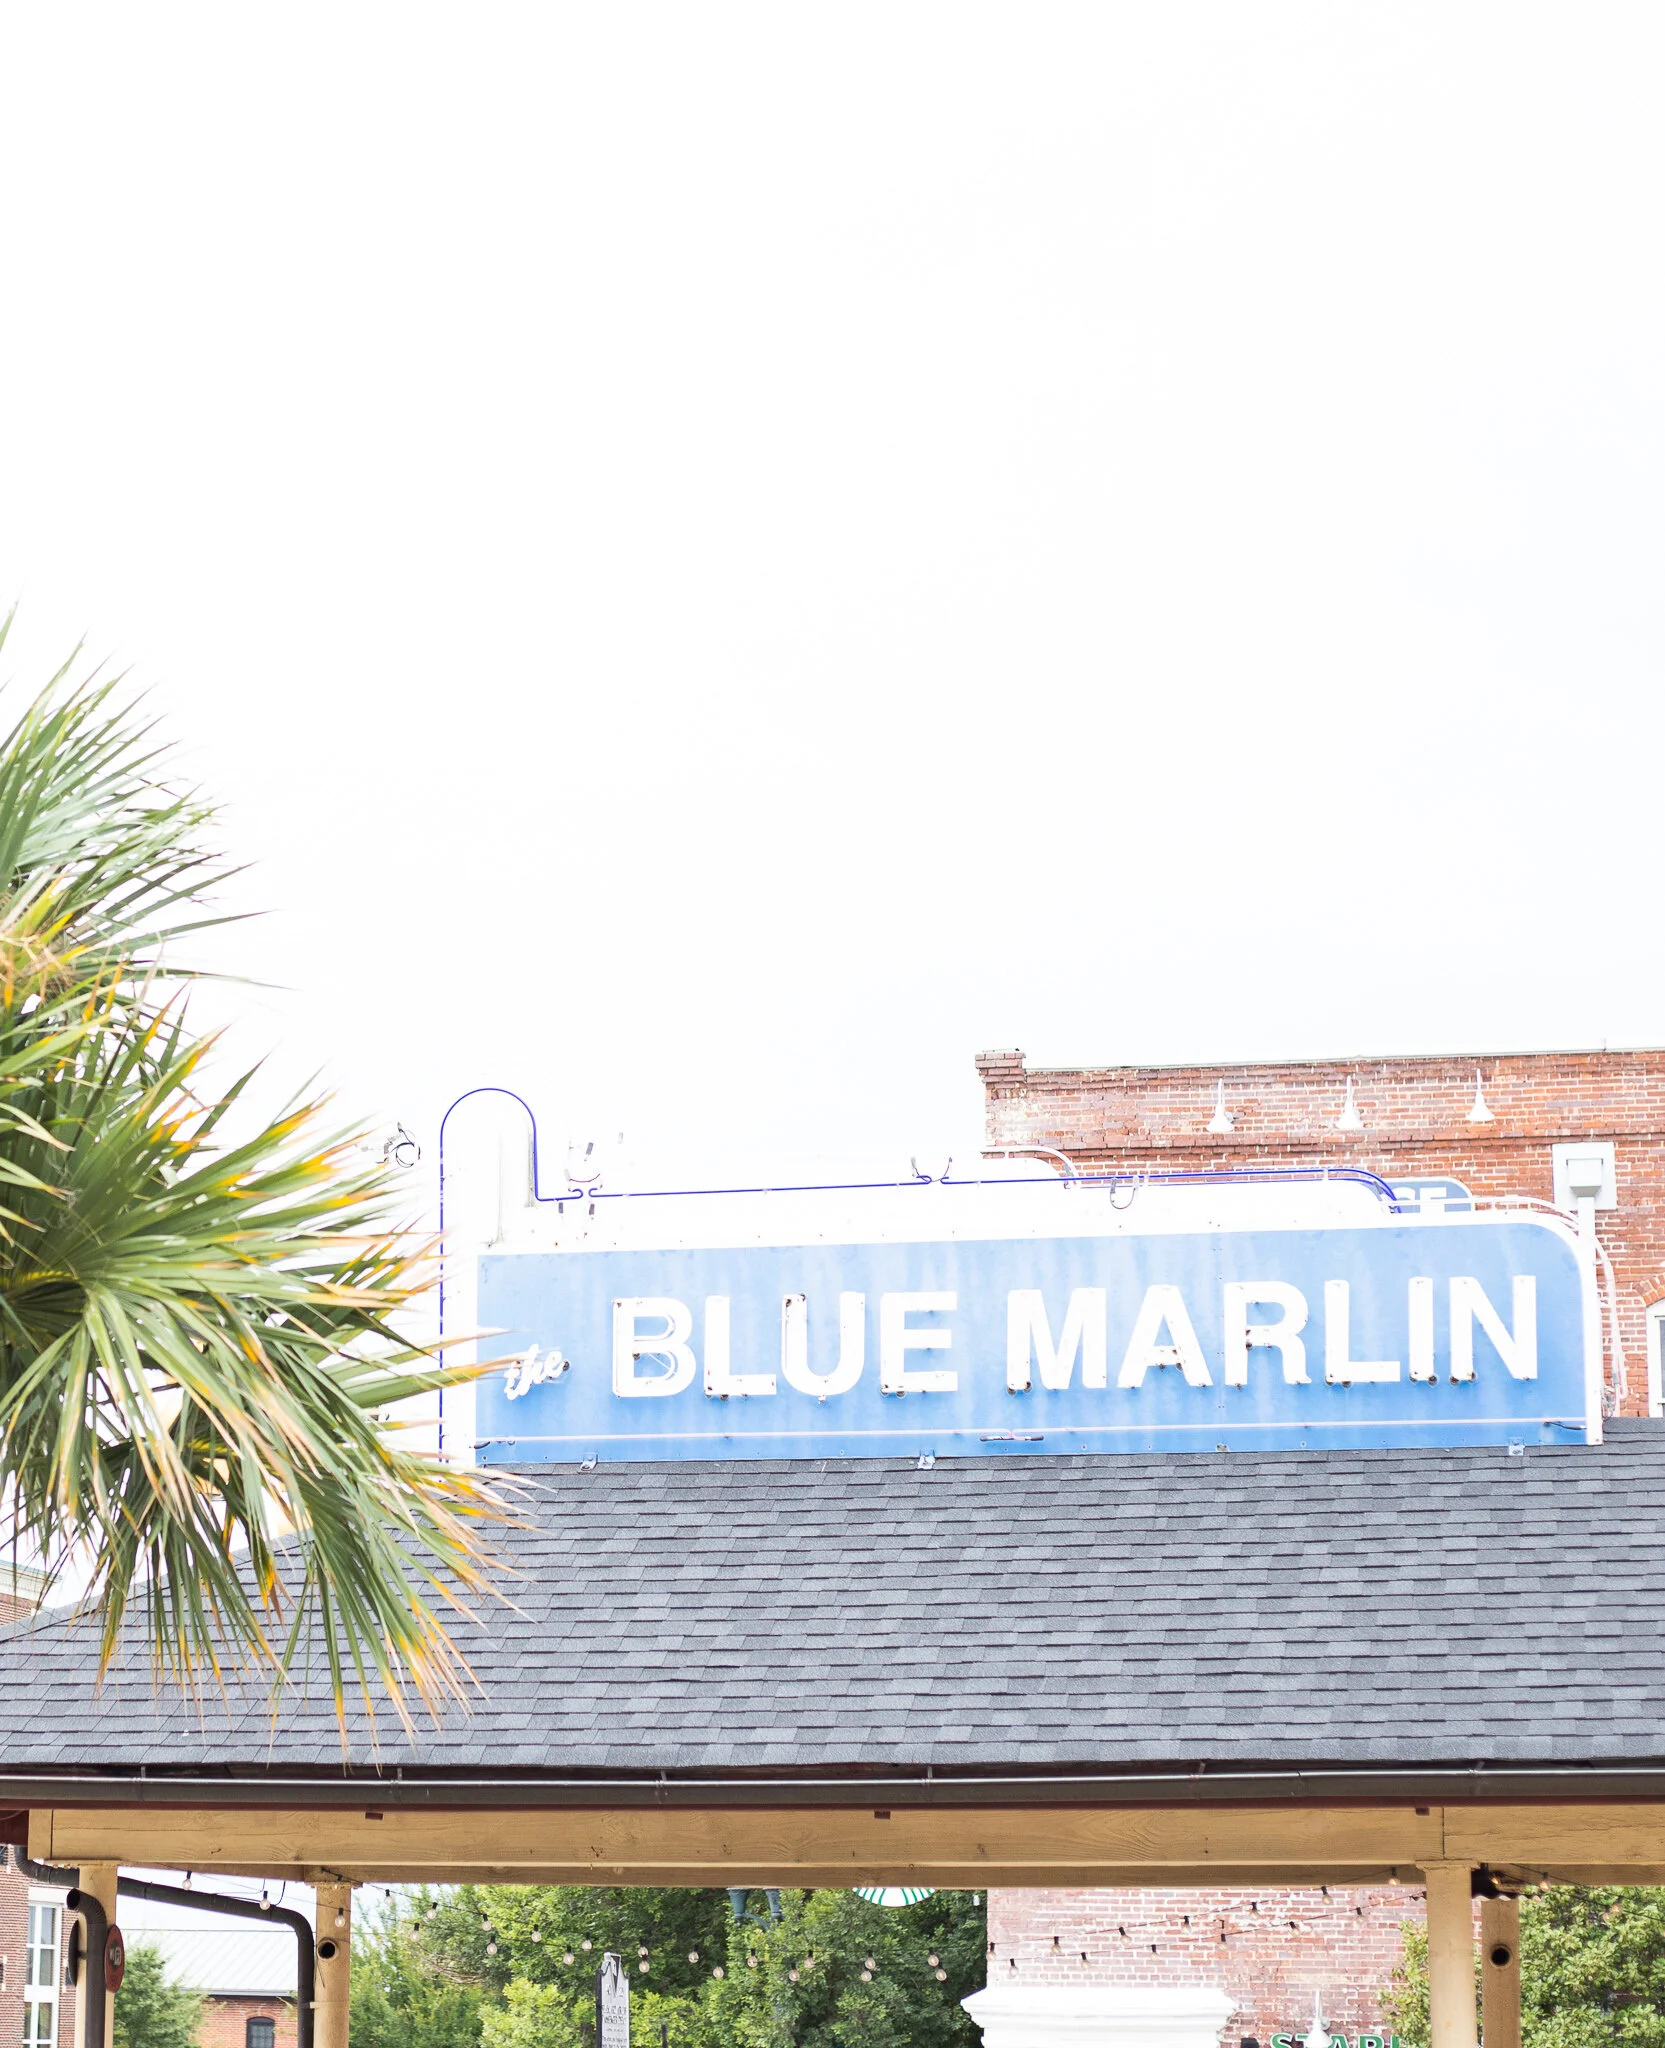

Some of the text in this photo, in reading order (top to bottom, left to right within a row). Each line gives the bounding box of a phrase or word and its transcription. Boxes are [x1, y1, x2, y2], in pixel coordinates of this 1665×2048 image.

[503, 1276, 1537, 1400] the BLUE MARLIN
